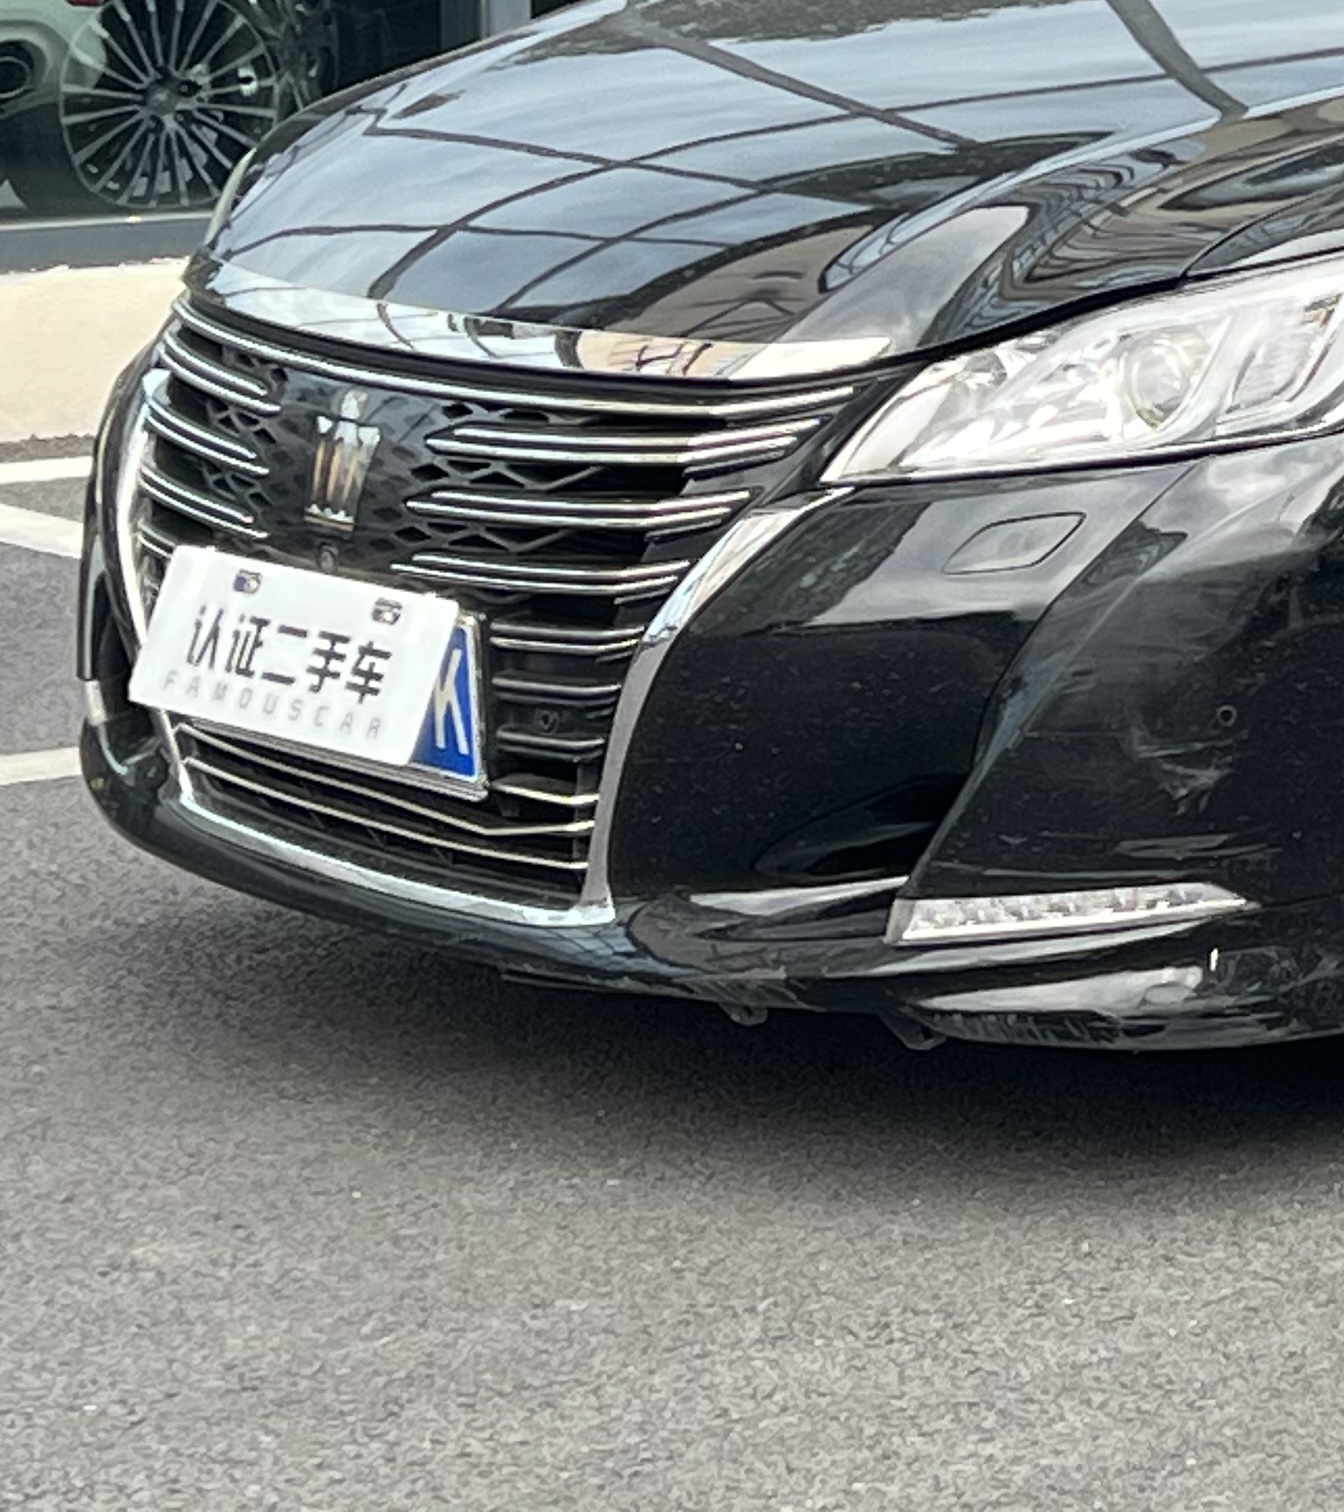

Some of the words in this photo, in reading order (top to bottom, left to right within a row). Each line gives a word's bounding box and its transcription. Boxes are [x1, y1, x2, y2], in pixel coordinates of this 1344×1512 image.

[186, 604, 393, 705] 认证二手车
[161, 669, 384, 741] FAMOUSCAR
